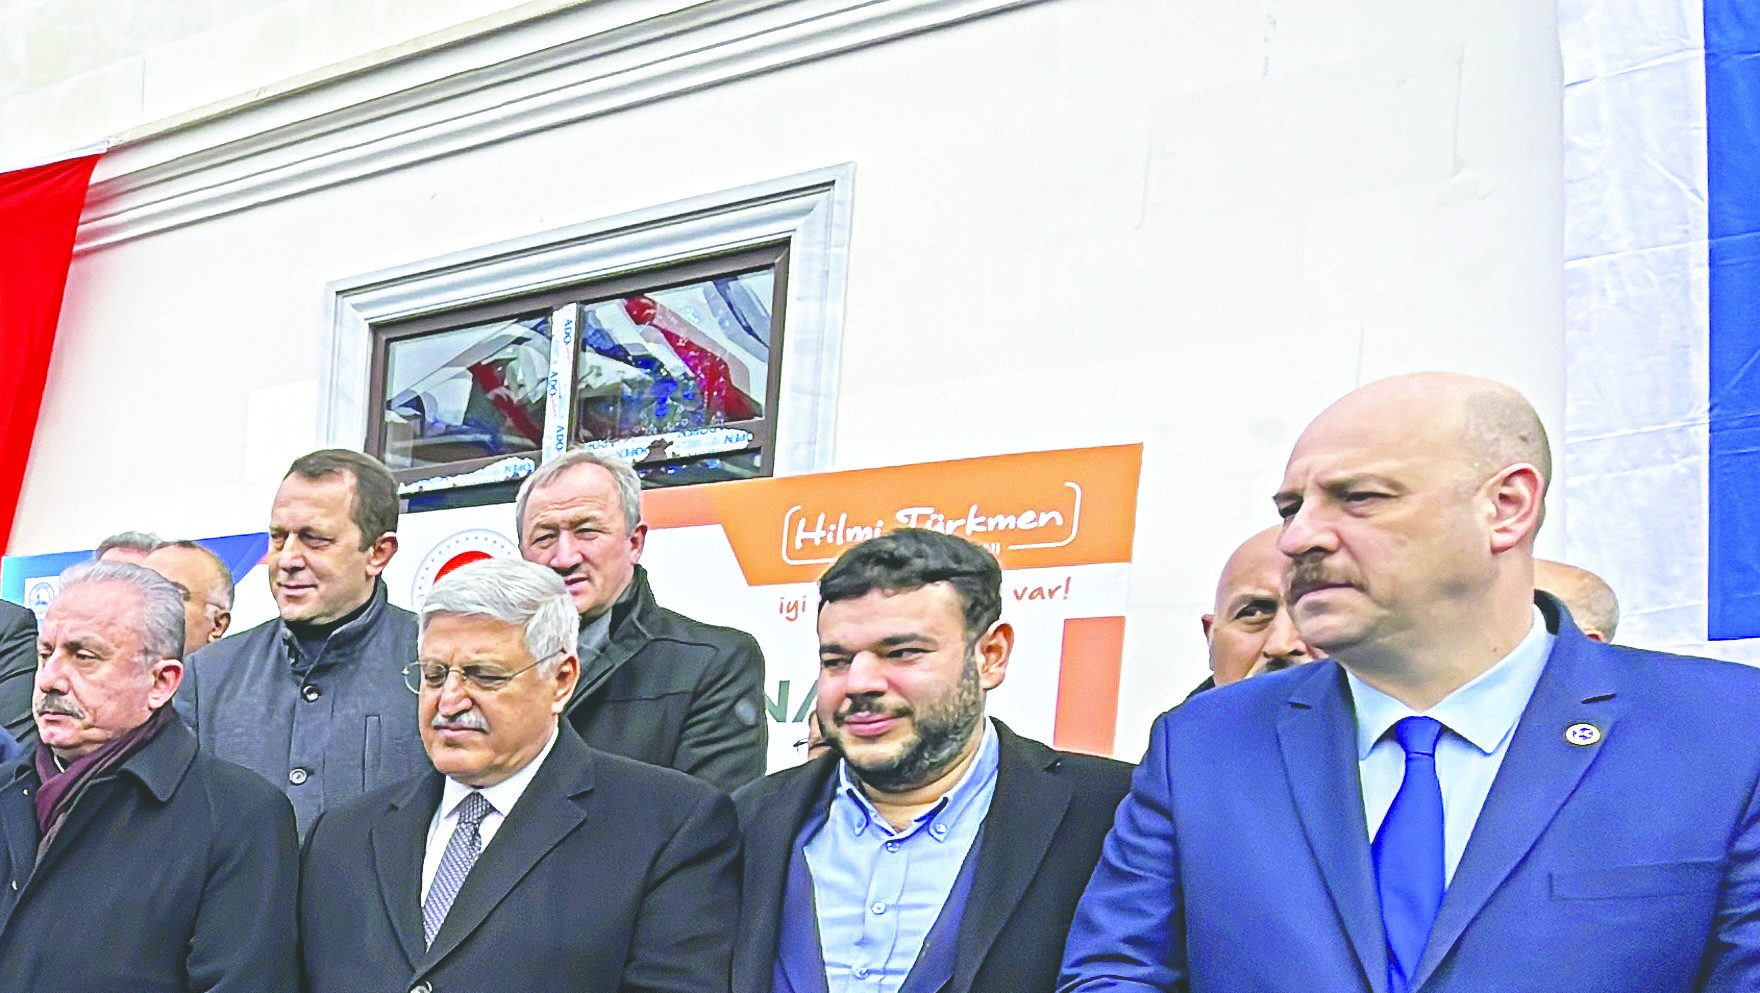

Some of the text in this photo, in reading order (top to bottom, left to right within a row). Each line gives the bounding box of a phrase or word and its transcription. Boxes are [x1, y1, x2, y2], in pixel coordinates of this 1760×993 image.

[794, 504, 1063, 550] Hilmi Türkmen
[778, 576, 1072, 622] iyi var!
